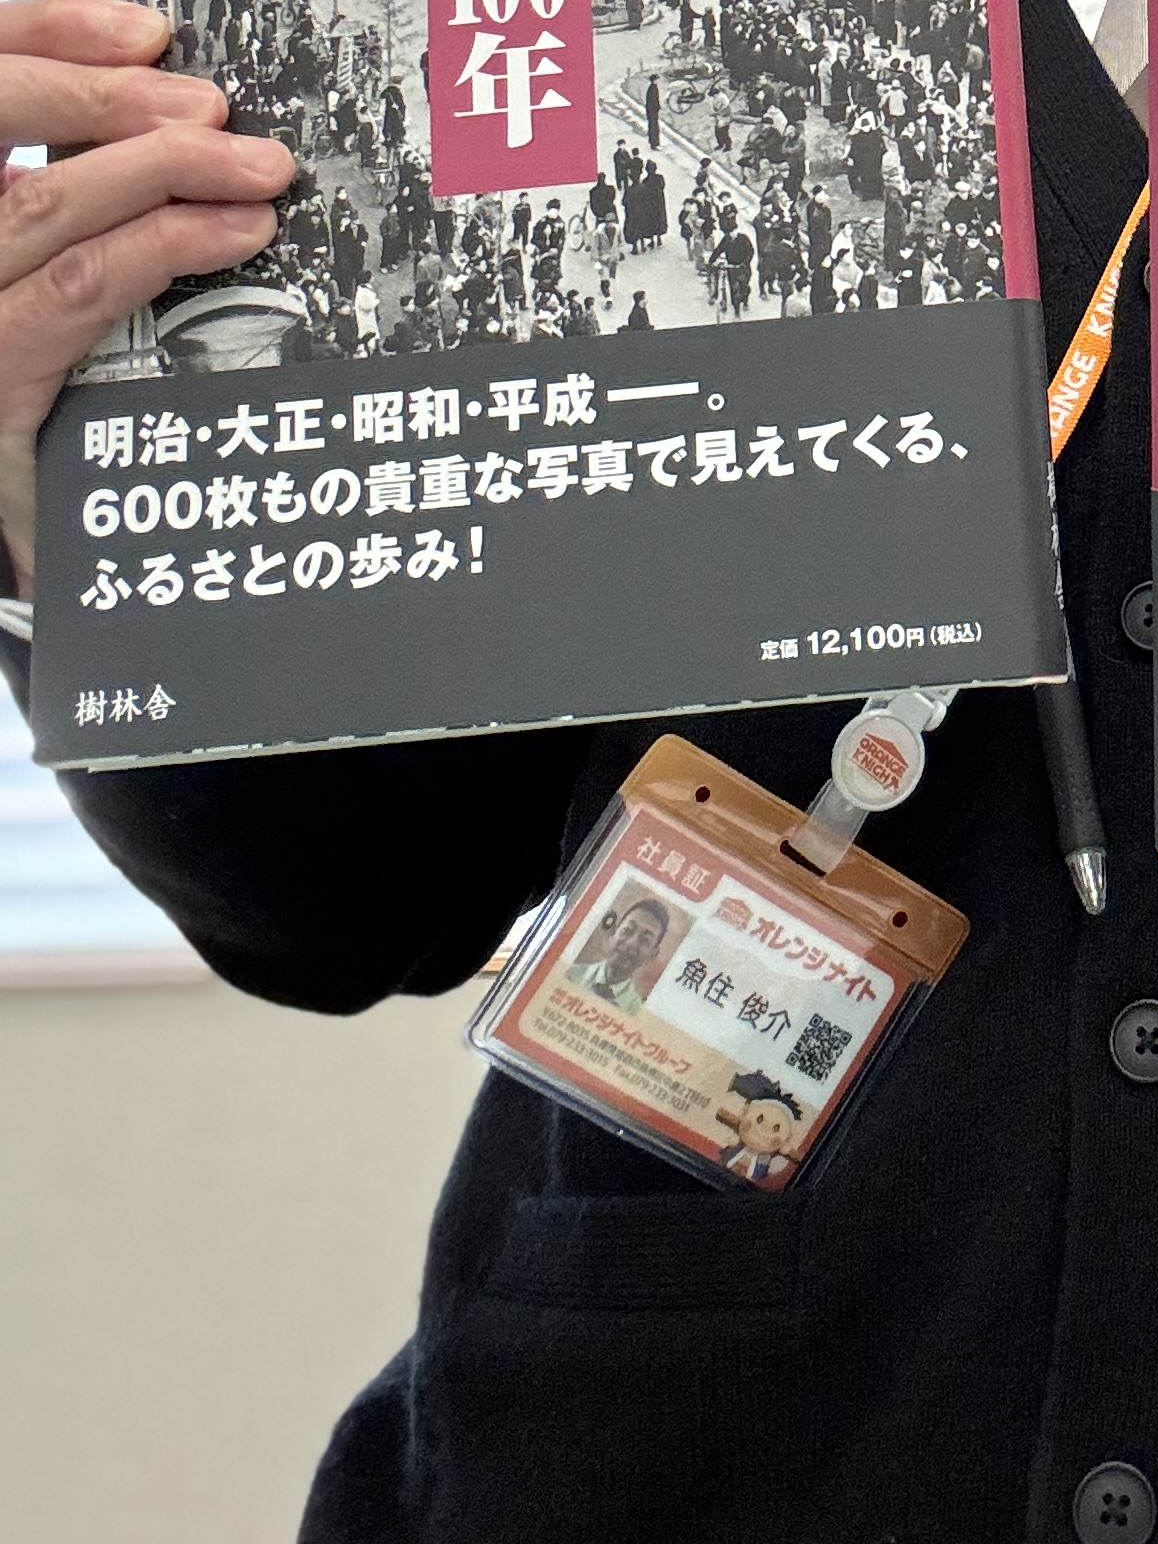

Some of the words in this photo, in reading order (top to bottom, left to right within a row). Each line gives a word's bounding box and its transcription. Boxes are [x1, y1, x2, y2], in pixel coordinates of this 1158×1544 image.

[1050, 348, 1096, 439] ANGE
[82, 412, 969, 538] 600枚もの貴重な写真で見えてくる、
[760, 639, 799, 661] 定価
[74, 683, 177, 727] 樹林舎
[860, 737, 906, 779] ORANGE
[636, 835, 711, 894] 社員証
[750, 916, 877, 1003] オレンジナイト
[675, 957, 735, 1009] 魚住
[737, 991, 792, 1042] 俊介
